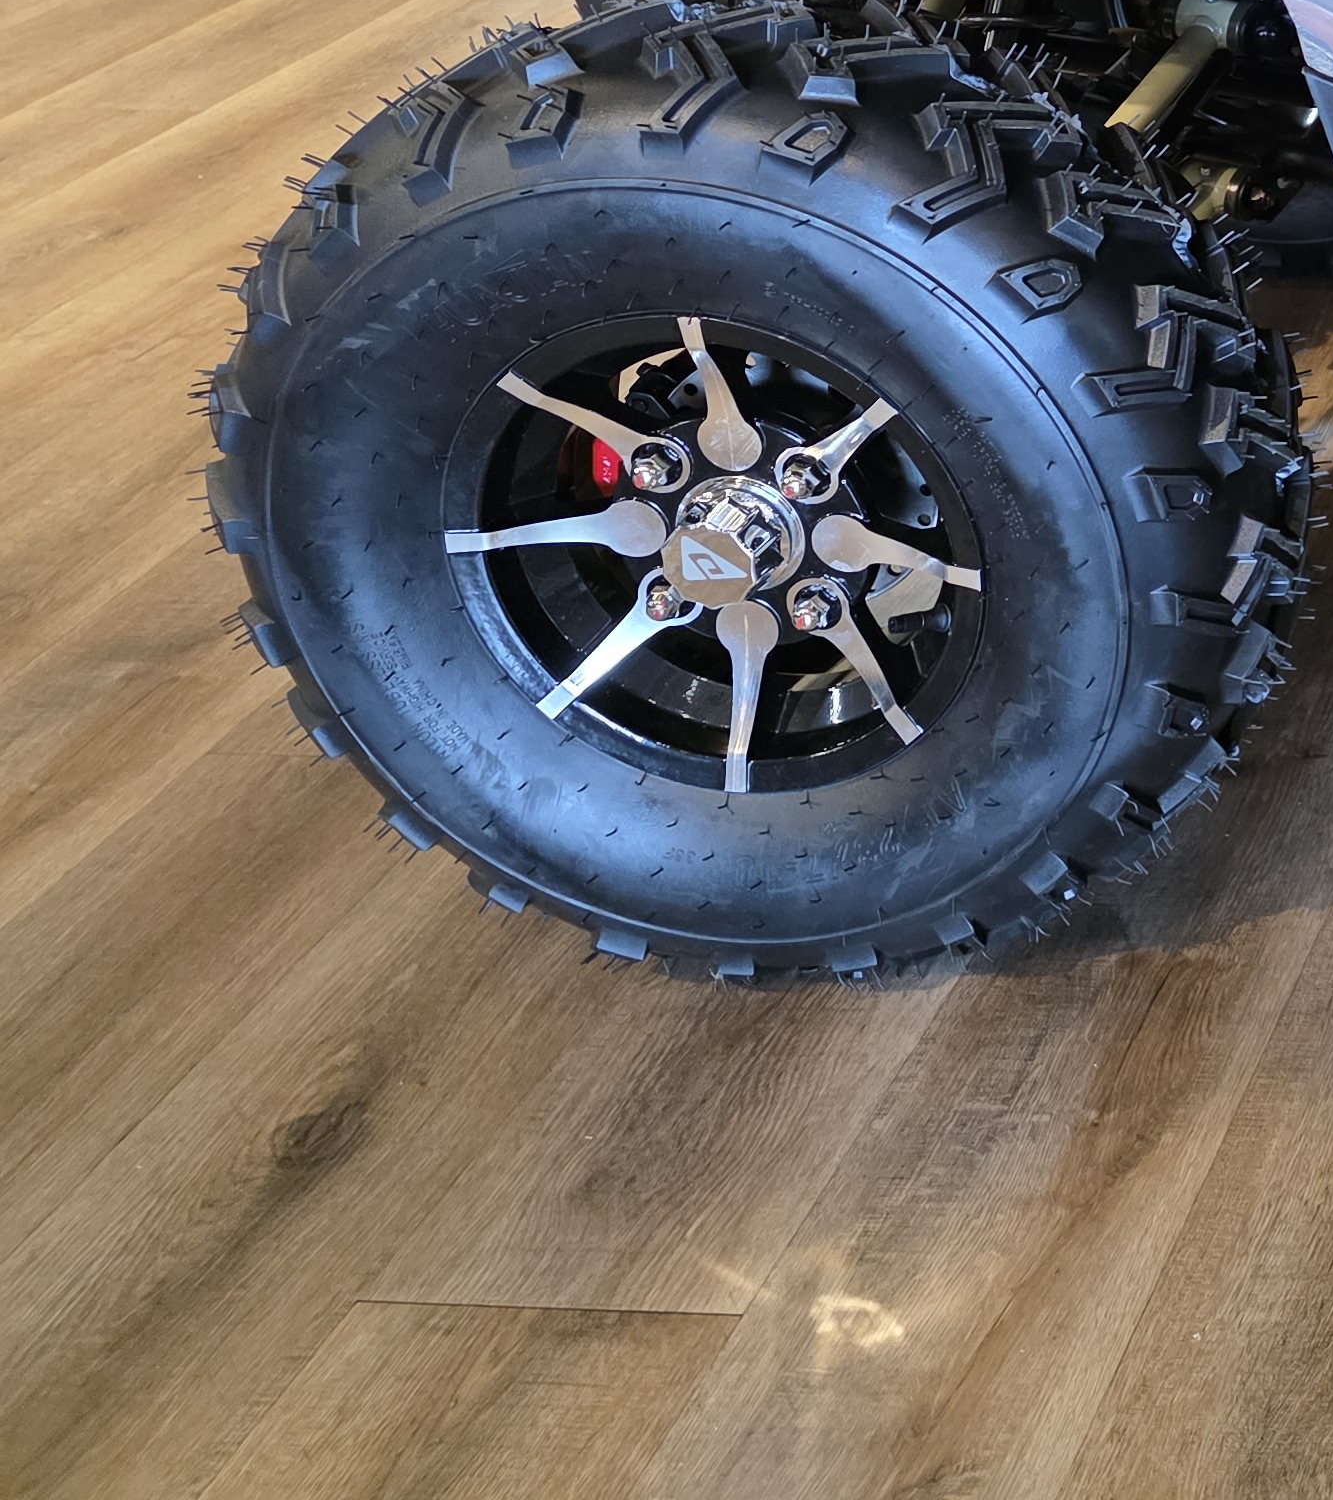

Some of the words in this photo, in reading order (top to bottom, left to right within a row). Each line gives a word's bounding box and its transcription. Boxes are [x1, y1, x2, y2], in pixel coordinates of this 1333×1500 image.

[413, 677, 439, 707] CHINA
[422, 713, 444, 736] FOR
[450, 720, 473, 746] MADE
[443, 733, 462, 753] NOT
